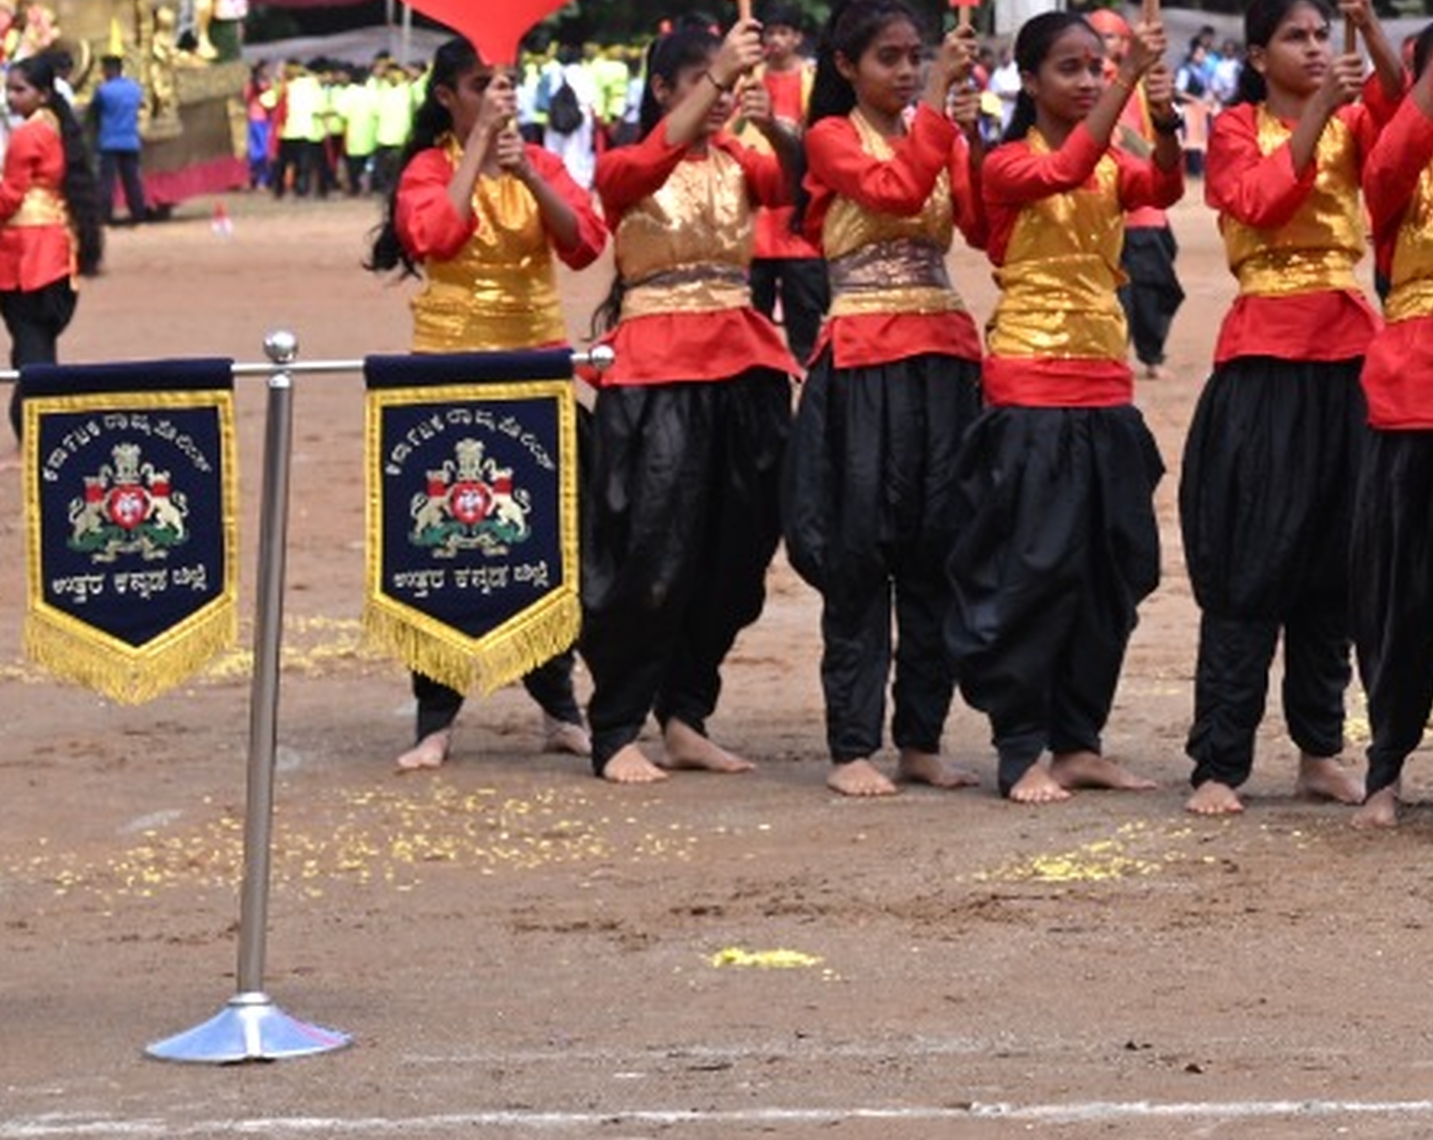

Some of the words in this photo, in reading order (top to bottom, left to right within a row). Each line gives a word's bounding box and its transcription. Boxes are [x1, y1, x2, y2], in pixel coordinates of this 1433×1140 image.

[53, 573, 105, 603] ಉತ್ತರ
[114, 568, 168, 599] ಕನ್ನಡ
[393, 569, 445, 598] ಉತ್ತರ
[454, 565, 509, 595] ಕನ್ನಡ
